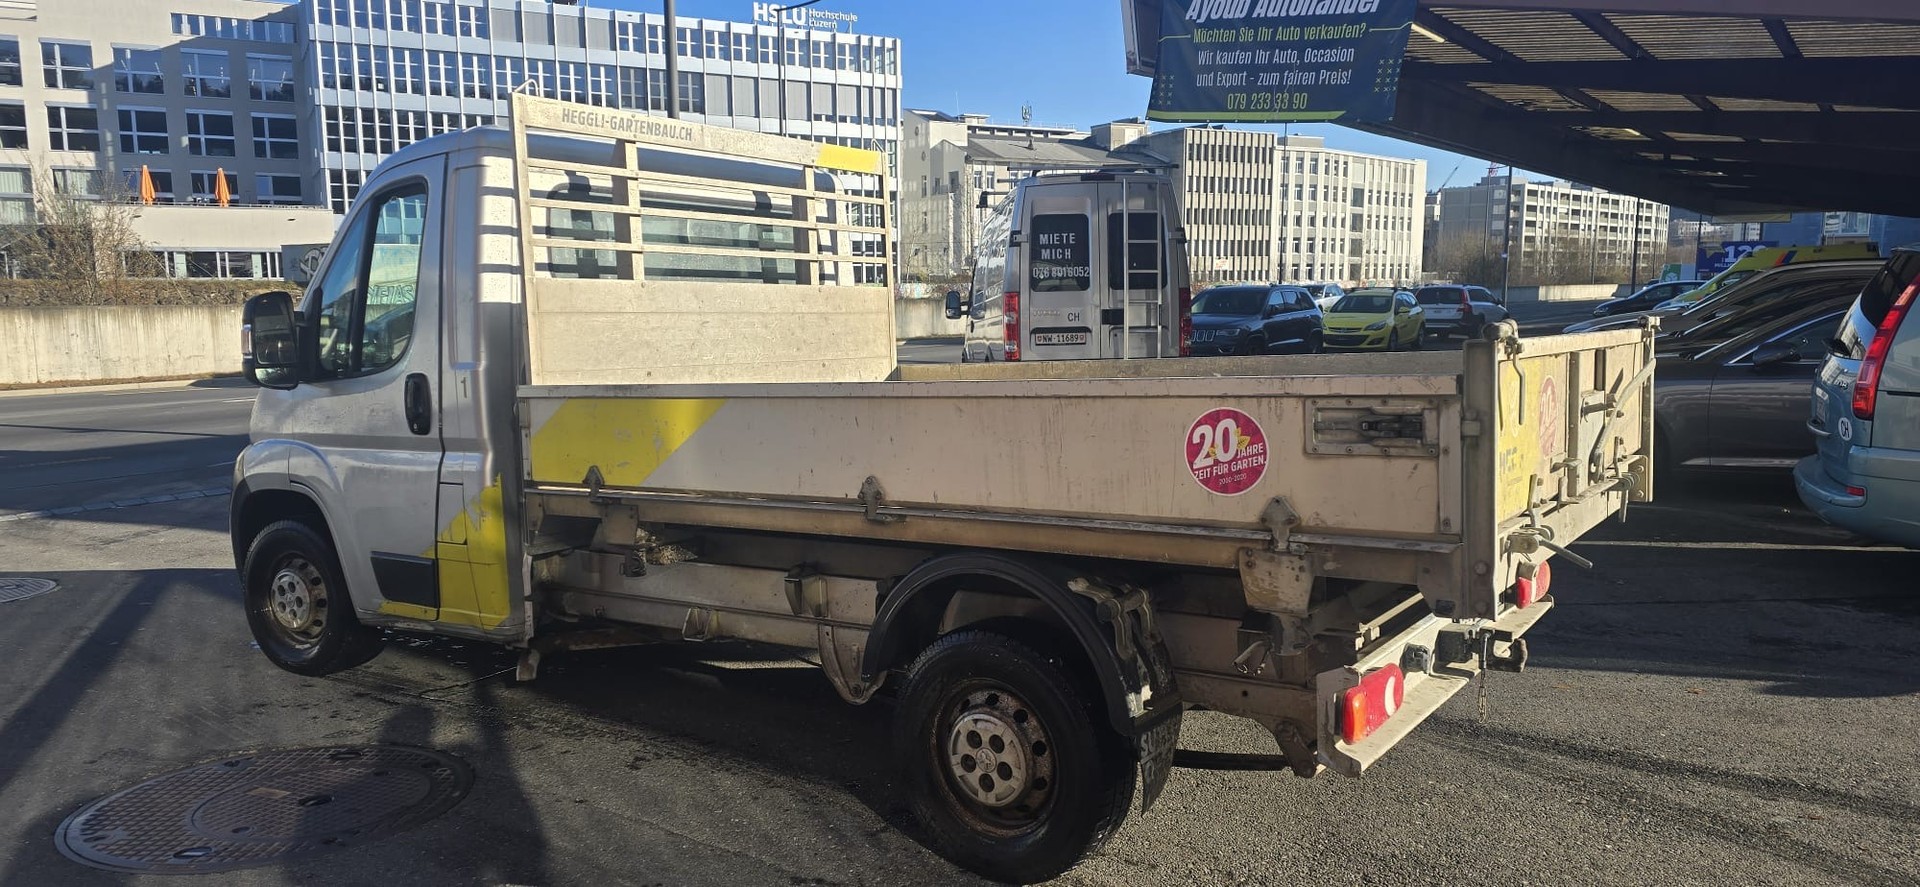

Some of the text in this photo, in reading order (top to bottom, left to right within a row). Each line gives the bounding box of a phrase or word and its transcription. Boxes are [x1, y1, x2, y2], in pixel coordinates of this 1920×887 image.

[753, 2, 807, 26] HSLU
[808, 8, 858, 22] Hochschule
[808, 18, 837, 29] Luzern
[1193, 23, 1367, 43] Möchten Sie Ihr Auto verkaufen?
[1198, 47, 1355, 65] Wir kaufen Ihr Auto, Occasion
[1196, 71, 1214, 86] und
[1216, 71, 1248, 88] Export
[1257, 73, 1280, 86] zum
[1283, 69, 1316, 86] fairen
[1319, 69, 1352, 85] Preis!
[1227, 93, 1309, 109] 079 233 33 90
[562, 108, 692, 142] HEGGLI-GARTENBAU.CH
[1039, 232, 1076, 245] MIETE
[1041, 248, 1071, 260] MICH
[1067, 312, 1080, 322] CH
[1840, 420, 1850, 438] CH
[1192, 418, 1239, 469] 20
[1237, 442, 1264, 459] JAHRE
[1194, 468, 1212, 480] ZEIT
[1213, 463, 1229, 477] FÜR
